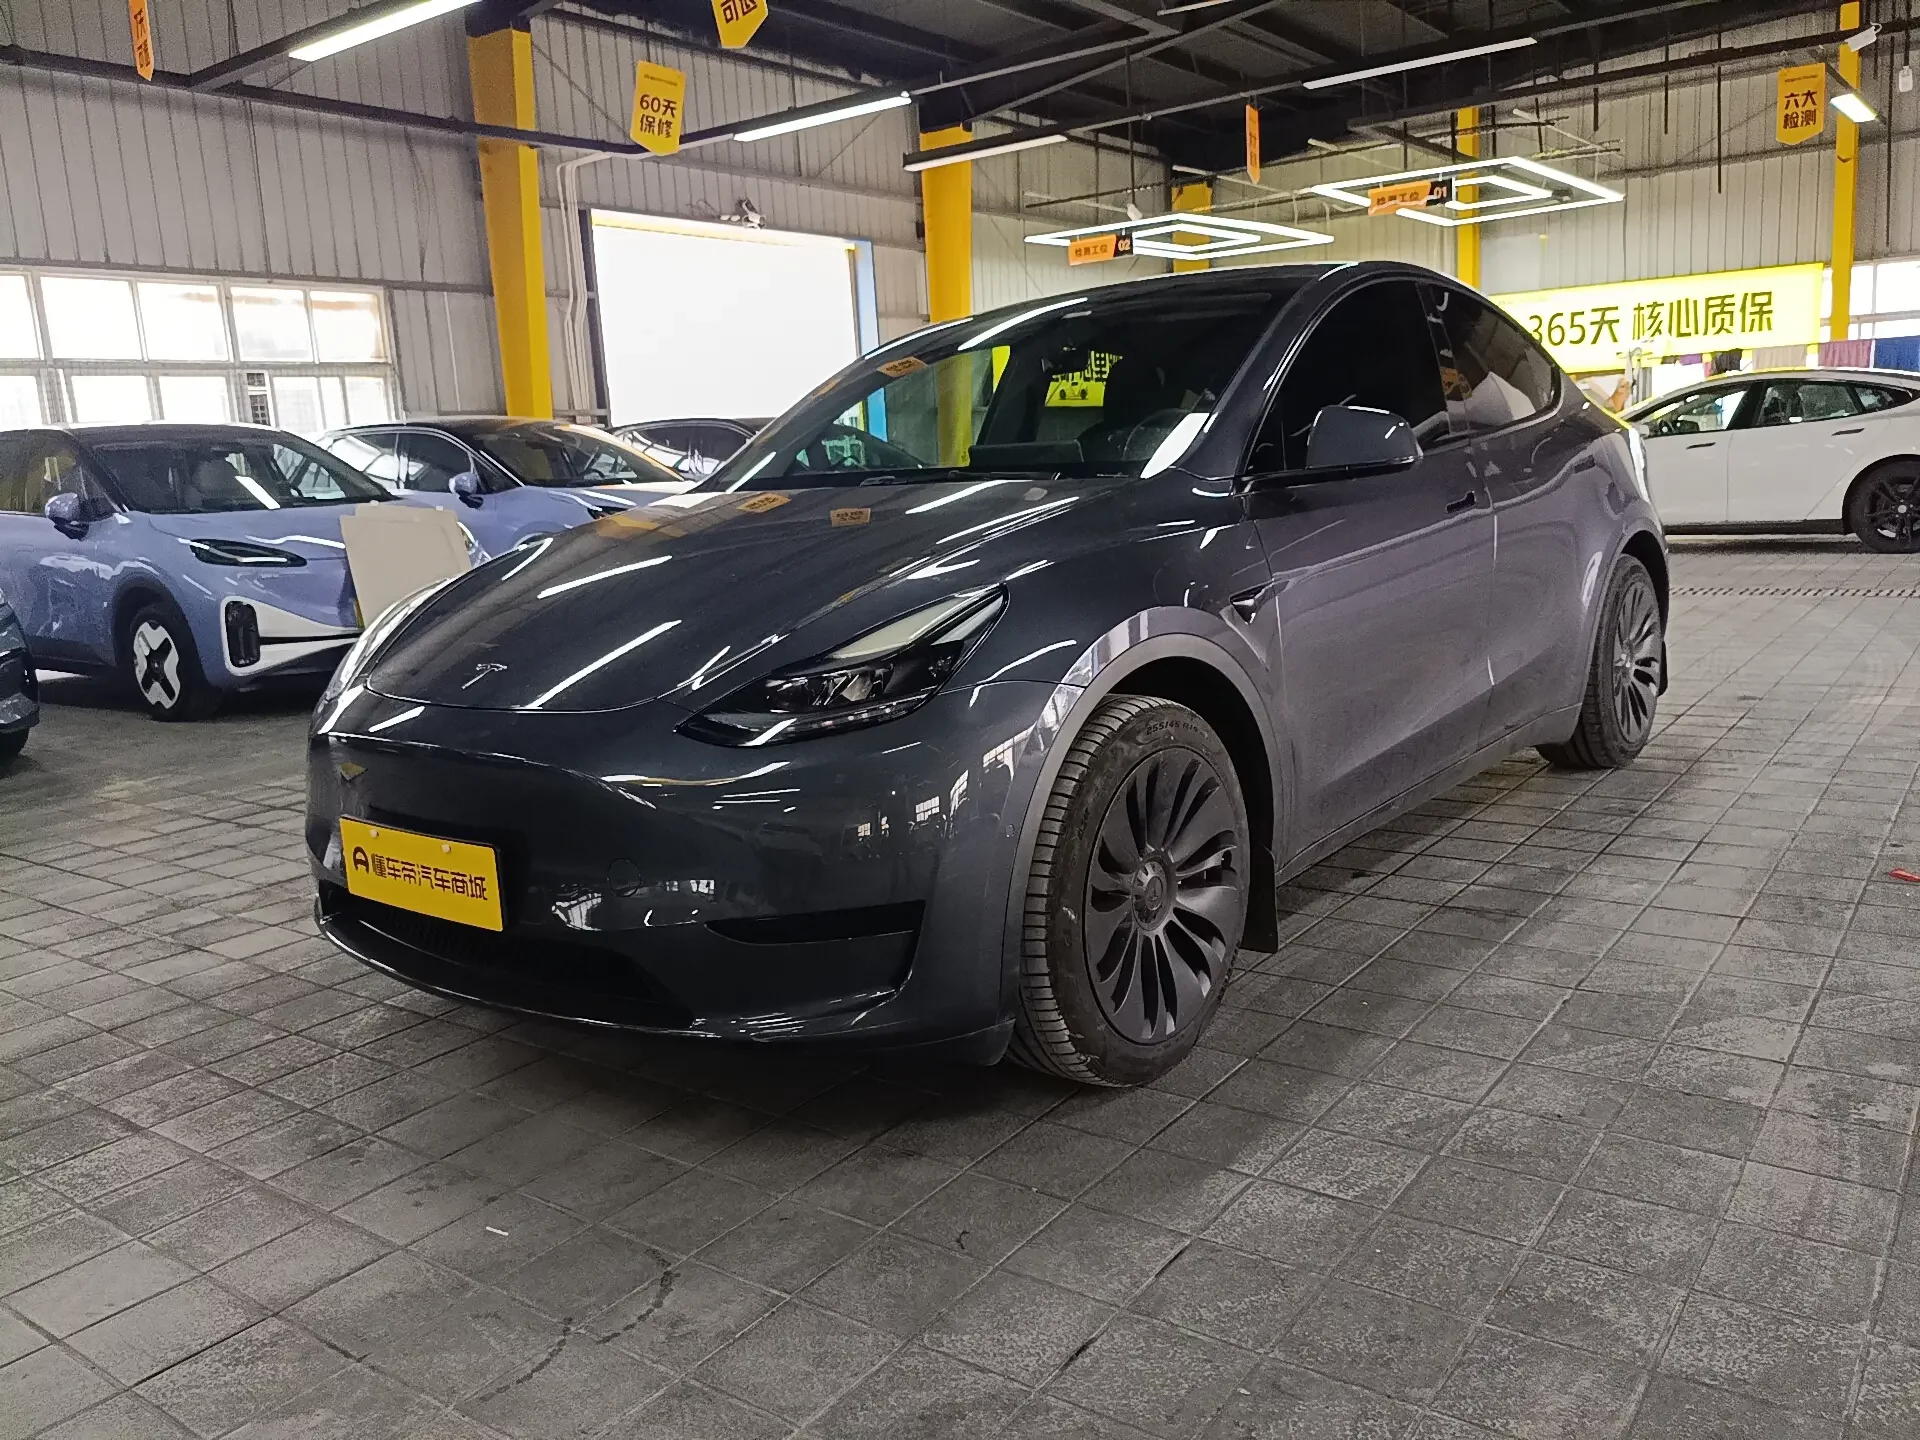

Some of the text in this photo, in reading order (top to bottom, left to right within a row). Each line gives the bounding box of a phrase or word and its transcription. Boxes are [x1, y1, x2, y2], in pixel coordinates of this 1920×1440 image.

[639, 93, 677, 119] 60天
[1784, 89, 1818, 110] 六大
[639, 113, 673, 139] 保修
[1783, 109, 1817, 130] 检测
[1433, 186, 1448, 200] 01
[1117, 237, 1131, 252] 02
[1528, 290, 1774, 347] 365天 核心质保
[370, 852, 489, 901] 懂车帝汽车商城
